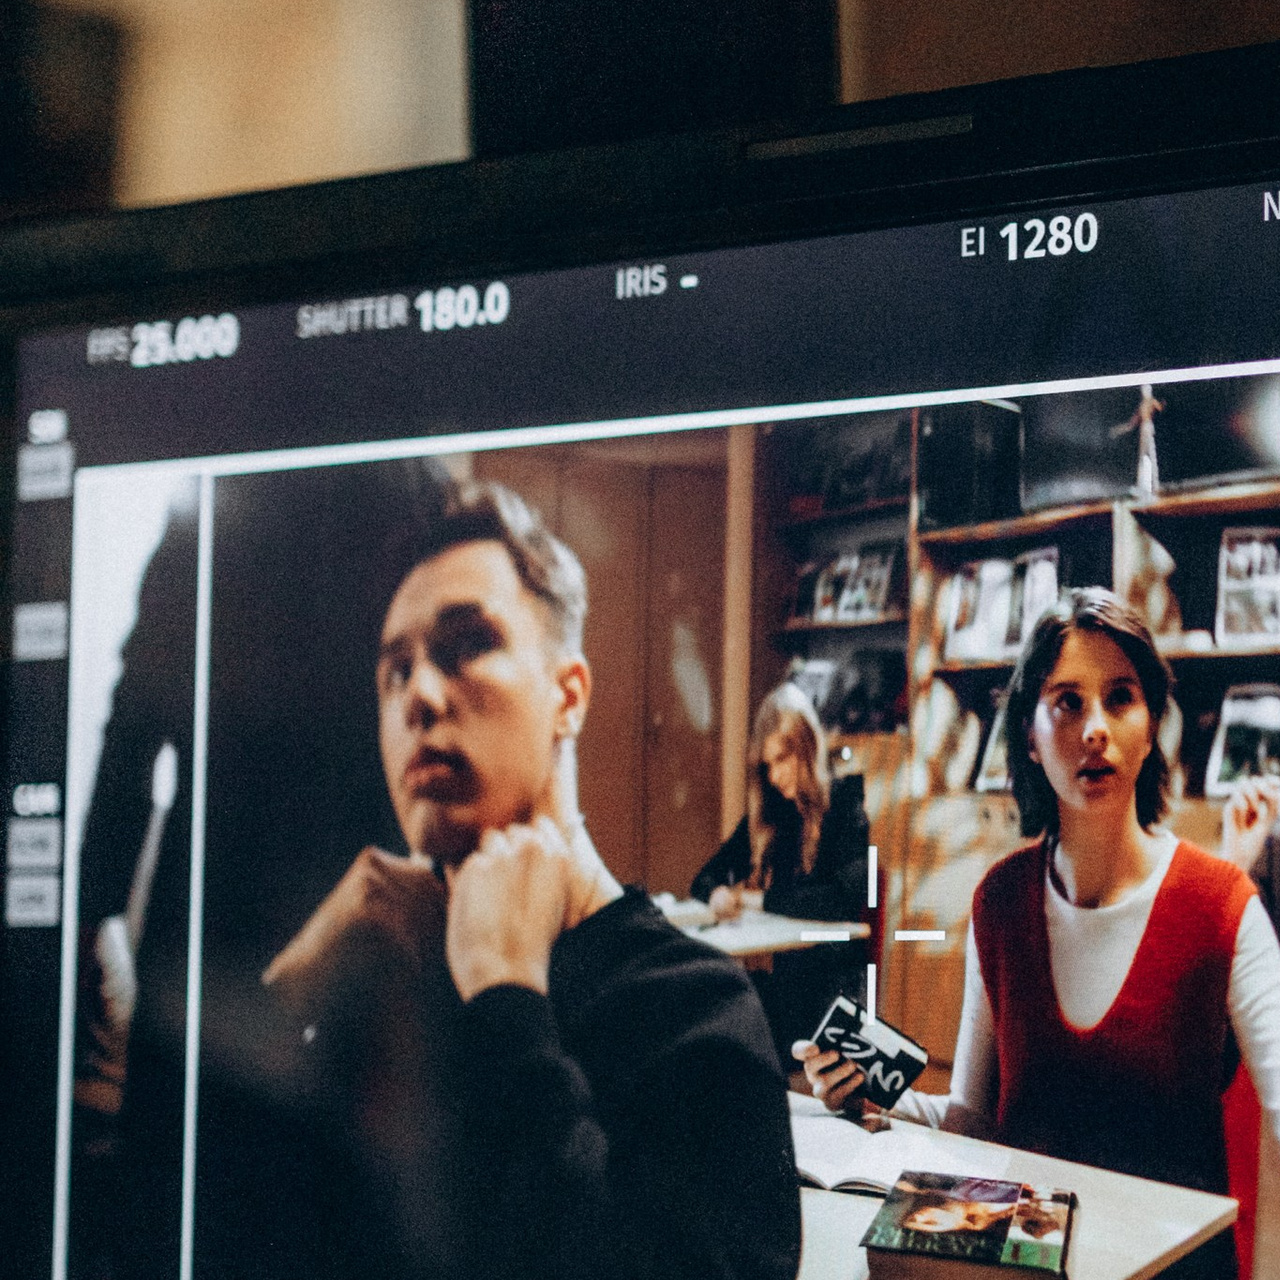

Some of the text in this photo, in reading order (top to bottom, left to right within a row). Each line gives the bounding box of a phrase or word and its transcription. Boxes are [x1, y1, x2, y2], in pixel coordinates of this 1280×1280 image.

[961, 212, 1099, 261] EI 1280
[615, 264, 668, 300] IRIS
[296, 281, 511, 339] SHUTTER 180.0
[130, 313, 241, 368] 25.000
